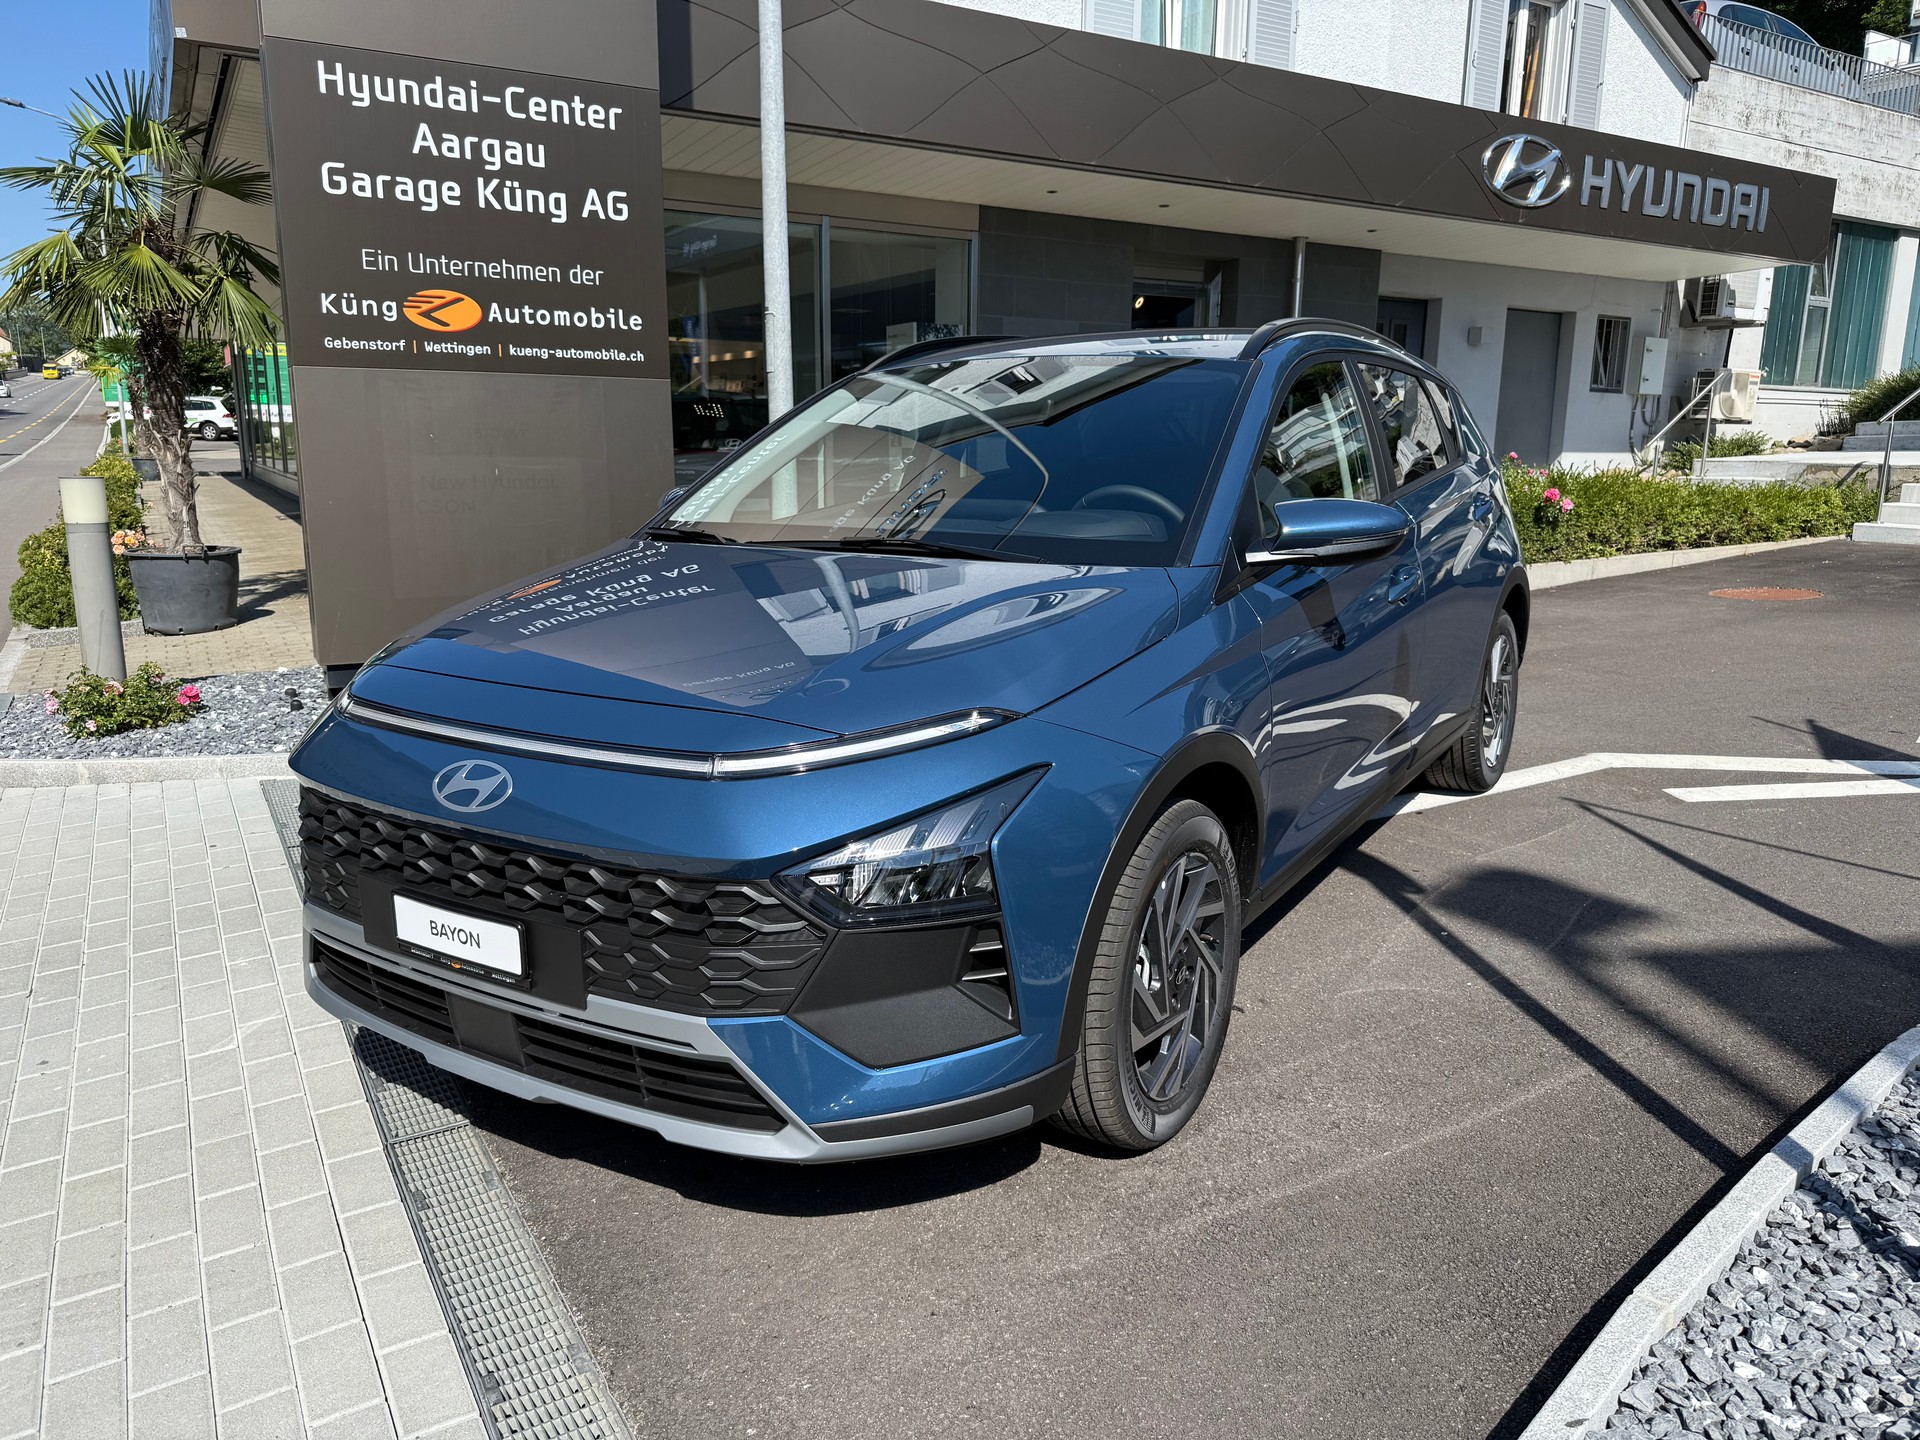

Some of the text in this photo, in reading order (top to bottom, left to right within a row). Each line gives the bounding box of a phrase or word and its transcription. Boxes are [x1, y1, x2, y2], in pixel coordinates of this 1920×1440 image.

[317, 60, 623, 131] Hyundai-Center
[412, 123, 546, 171] Aargau
[321, 161, 630, 223] Garage Küng AG
[1579, 154, 1770, 233] HYUNDAI
[361, 248, 604, 286] Ein Unternehmen der
[320, 292, 643, 331] Küng Automobile
[324, 336, 645, 363] Gebenstorf Wettingen kueng-automobile.ch
[429, 919, 481, 949] BAYON
